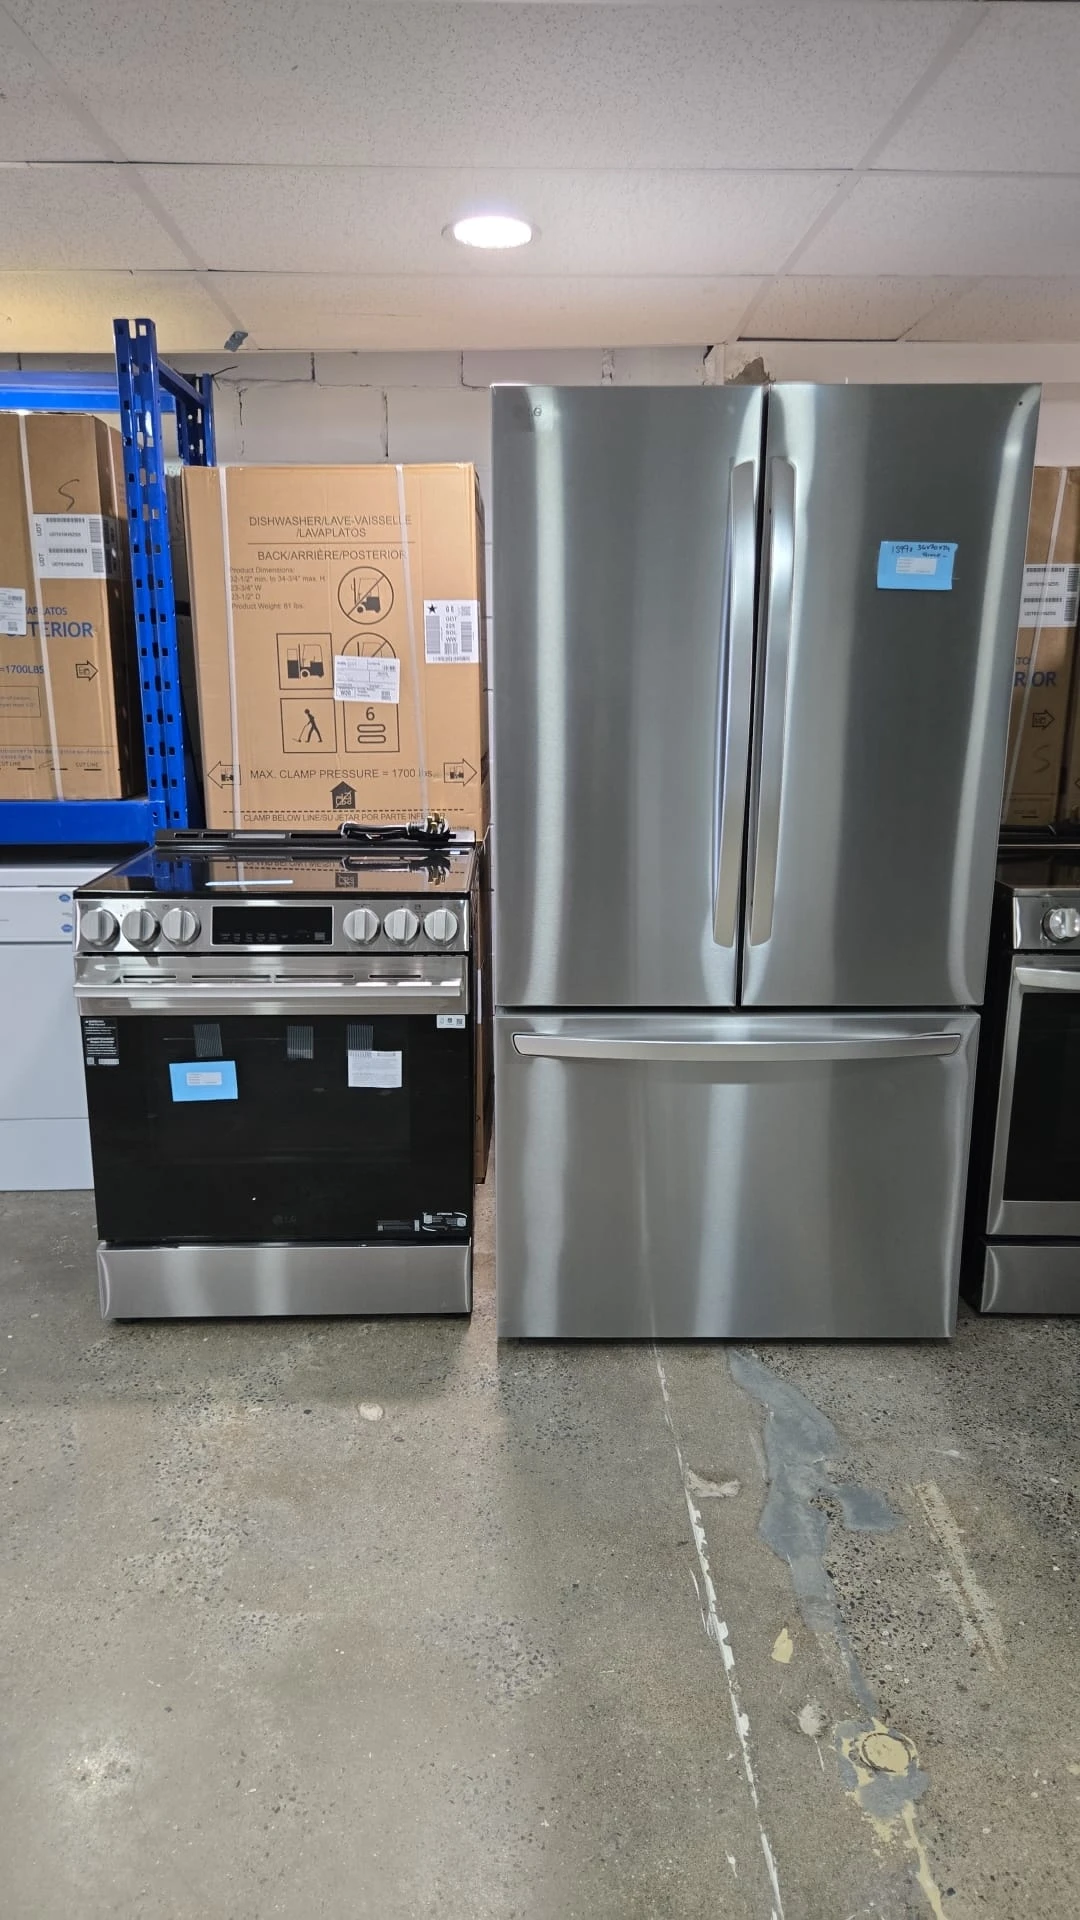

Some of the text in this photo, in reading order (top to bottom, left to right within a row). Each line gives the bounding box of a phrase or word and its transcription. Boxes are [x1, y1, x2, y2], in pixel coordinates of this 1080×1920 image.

[58, 478, 80, 512] S
[249, 515, 412, 527] DISHWASHER/LAVE-VAISSELLE
[296, 528, 367, 538] /LAVAPLATOS
[257, 549, 408, 561] BACK/ARRIÈRE/POSTERIOR
[232, 602, 256, 610] Product
[1014, 671, 1057, 687] ROR
[365, 706, 375, 721] 6
[250, 769, 276, 780] MAX.
[279, 769, 317, 779] CLAMP
[319, 768, 379, 779] PRESSURE
[392, 767, 416, 778] 1700
[243, 814, 271, 822] CLAMP
[272, 814, 300, 822] BELOW
[361, 813, 379, 821] POR
[380, 813, 407, 821] PARTE
